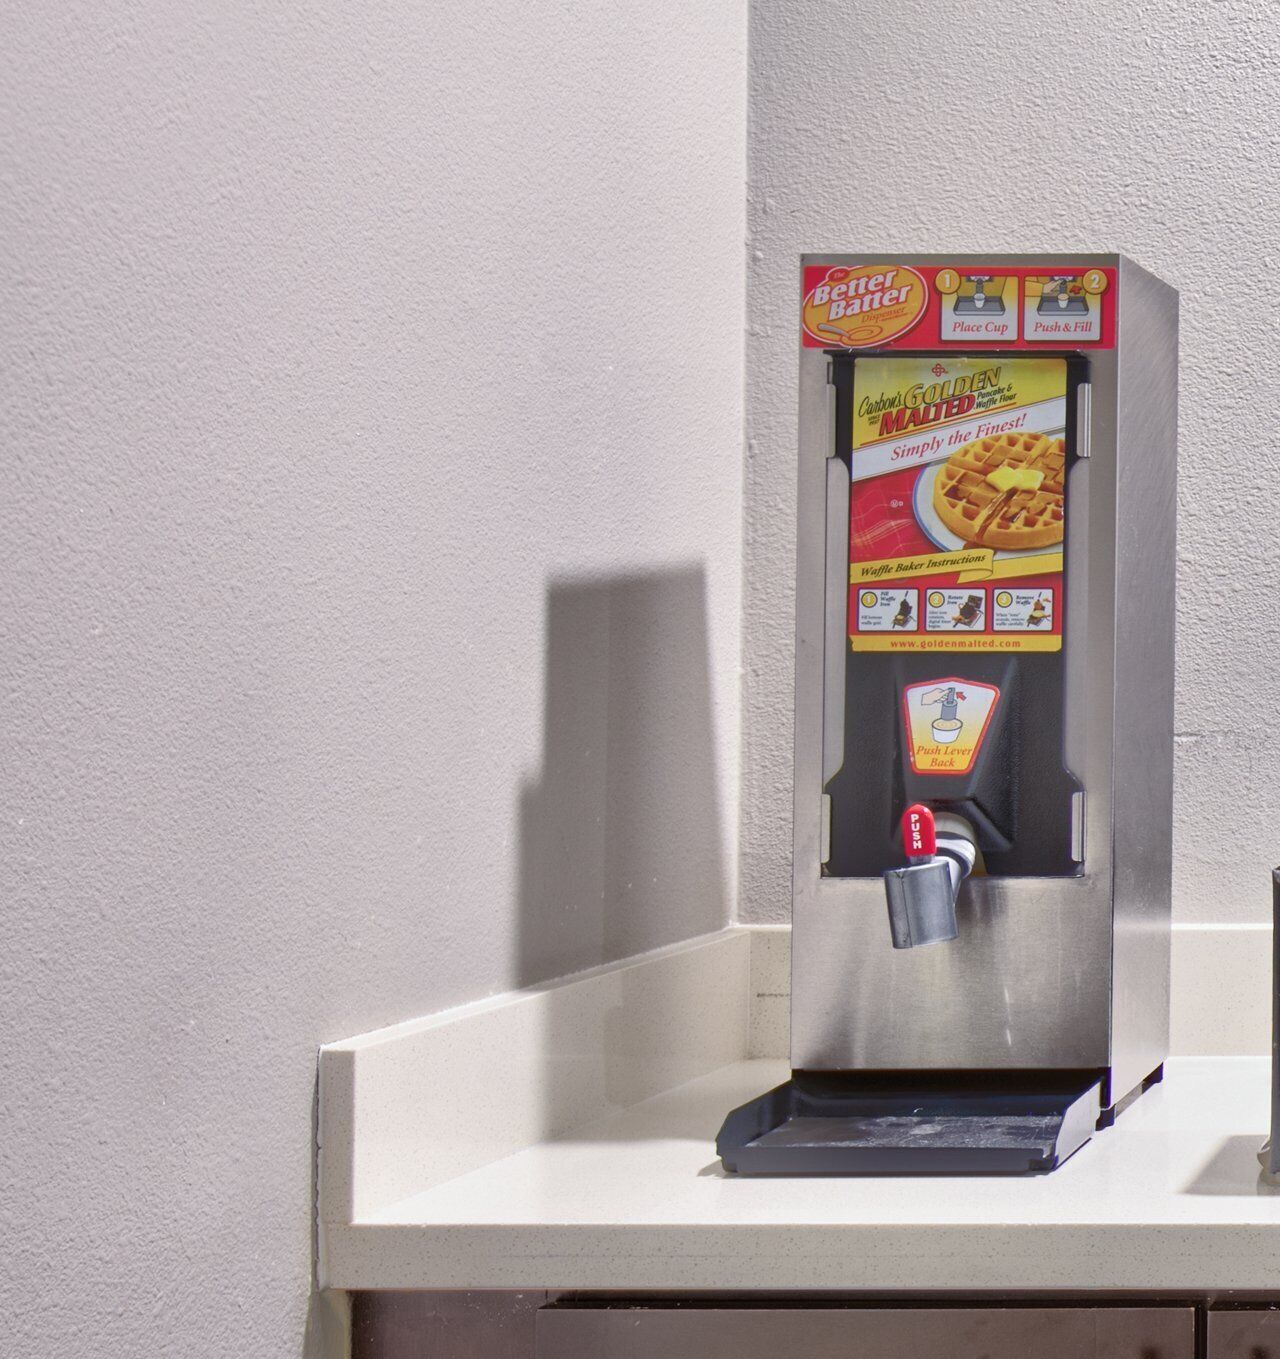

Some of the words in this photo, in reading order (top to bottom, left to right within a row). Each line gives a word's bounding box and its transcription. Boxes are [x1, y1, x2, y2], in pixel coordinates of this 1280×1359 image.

[813, 270, 898, 306] Better
[1090, 274, 1100, 288] 2
[828, 285, 912, 321] Batter
[861, 306, 906, 323] Dispenser
[952, 321, 982, 333] Place
[985, 321, 1008, 335] Cup
[1034, 321, 1061, 333] Push
[1062, 322, 1071, 333] &
[1072, 321, 1093, 333] Fill
[858, 390, 902, 417] Carbon's
[903, 366, 1002, 409] GOLDEN
[977, 385, 1006, 401] Pancake
[976, 396, 998, 409] Waffle
[999, 393, 1017, 404] Flour
[879, 393, 977, 437] MALTED
[891, 436, 943, 461] Simply
[948, 427, 973, 446] the
[975, 413, 1027, 440] Finest!
[861, 564, 894, 578] Waffle
[895, 562, 925, 575] Baker
[926, 554, 986, 569] Instructions
[891, 638, 1021, 649] www.goldenmalted.com
[916, 745, 941, 756] Push
[943, 745, 972, 756] Lever
[930, 757, 955, 768] Back
[910, 814, 922, 849] PUSH
